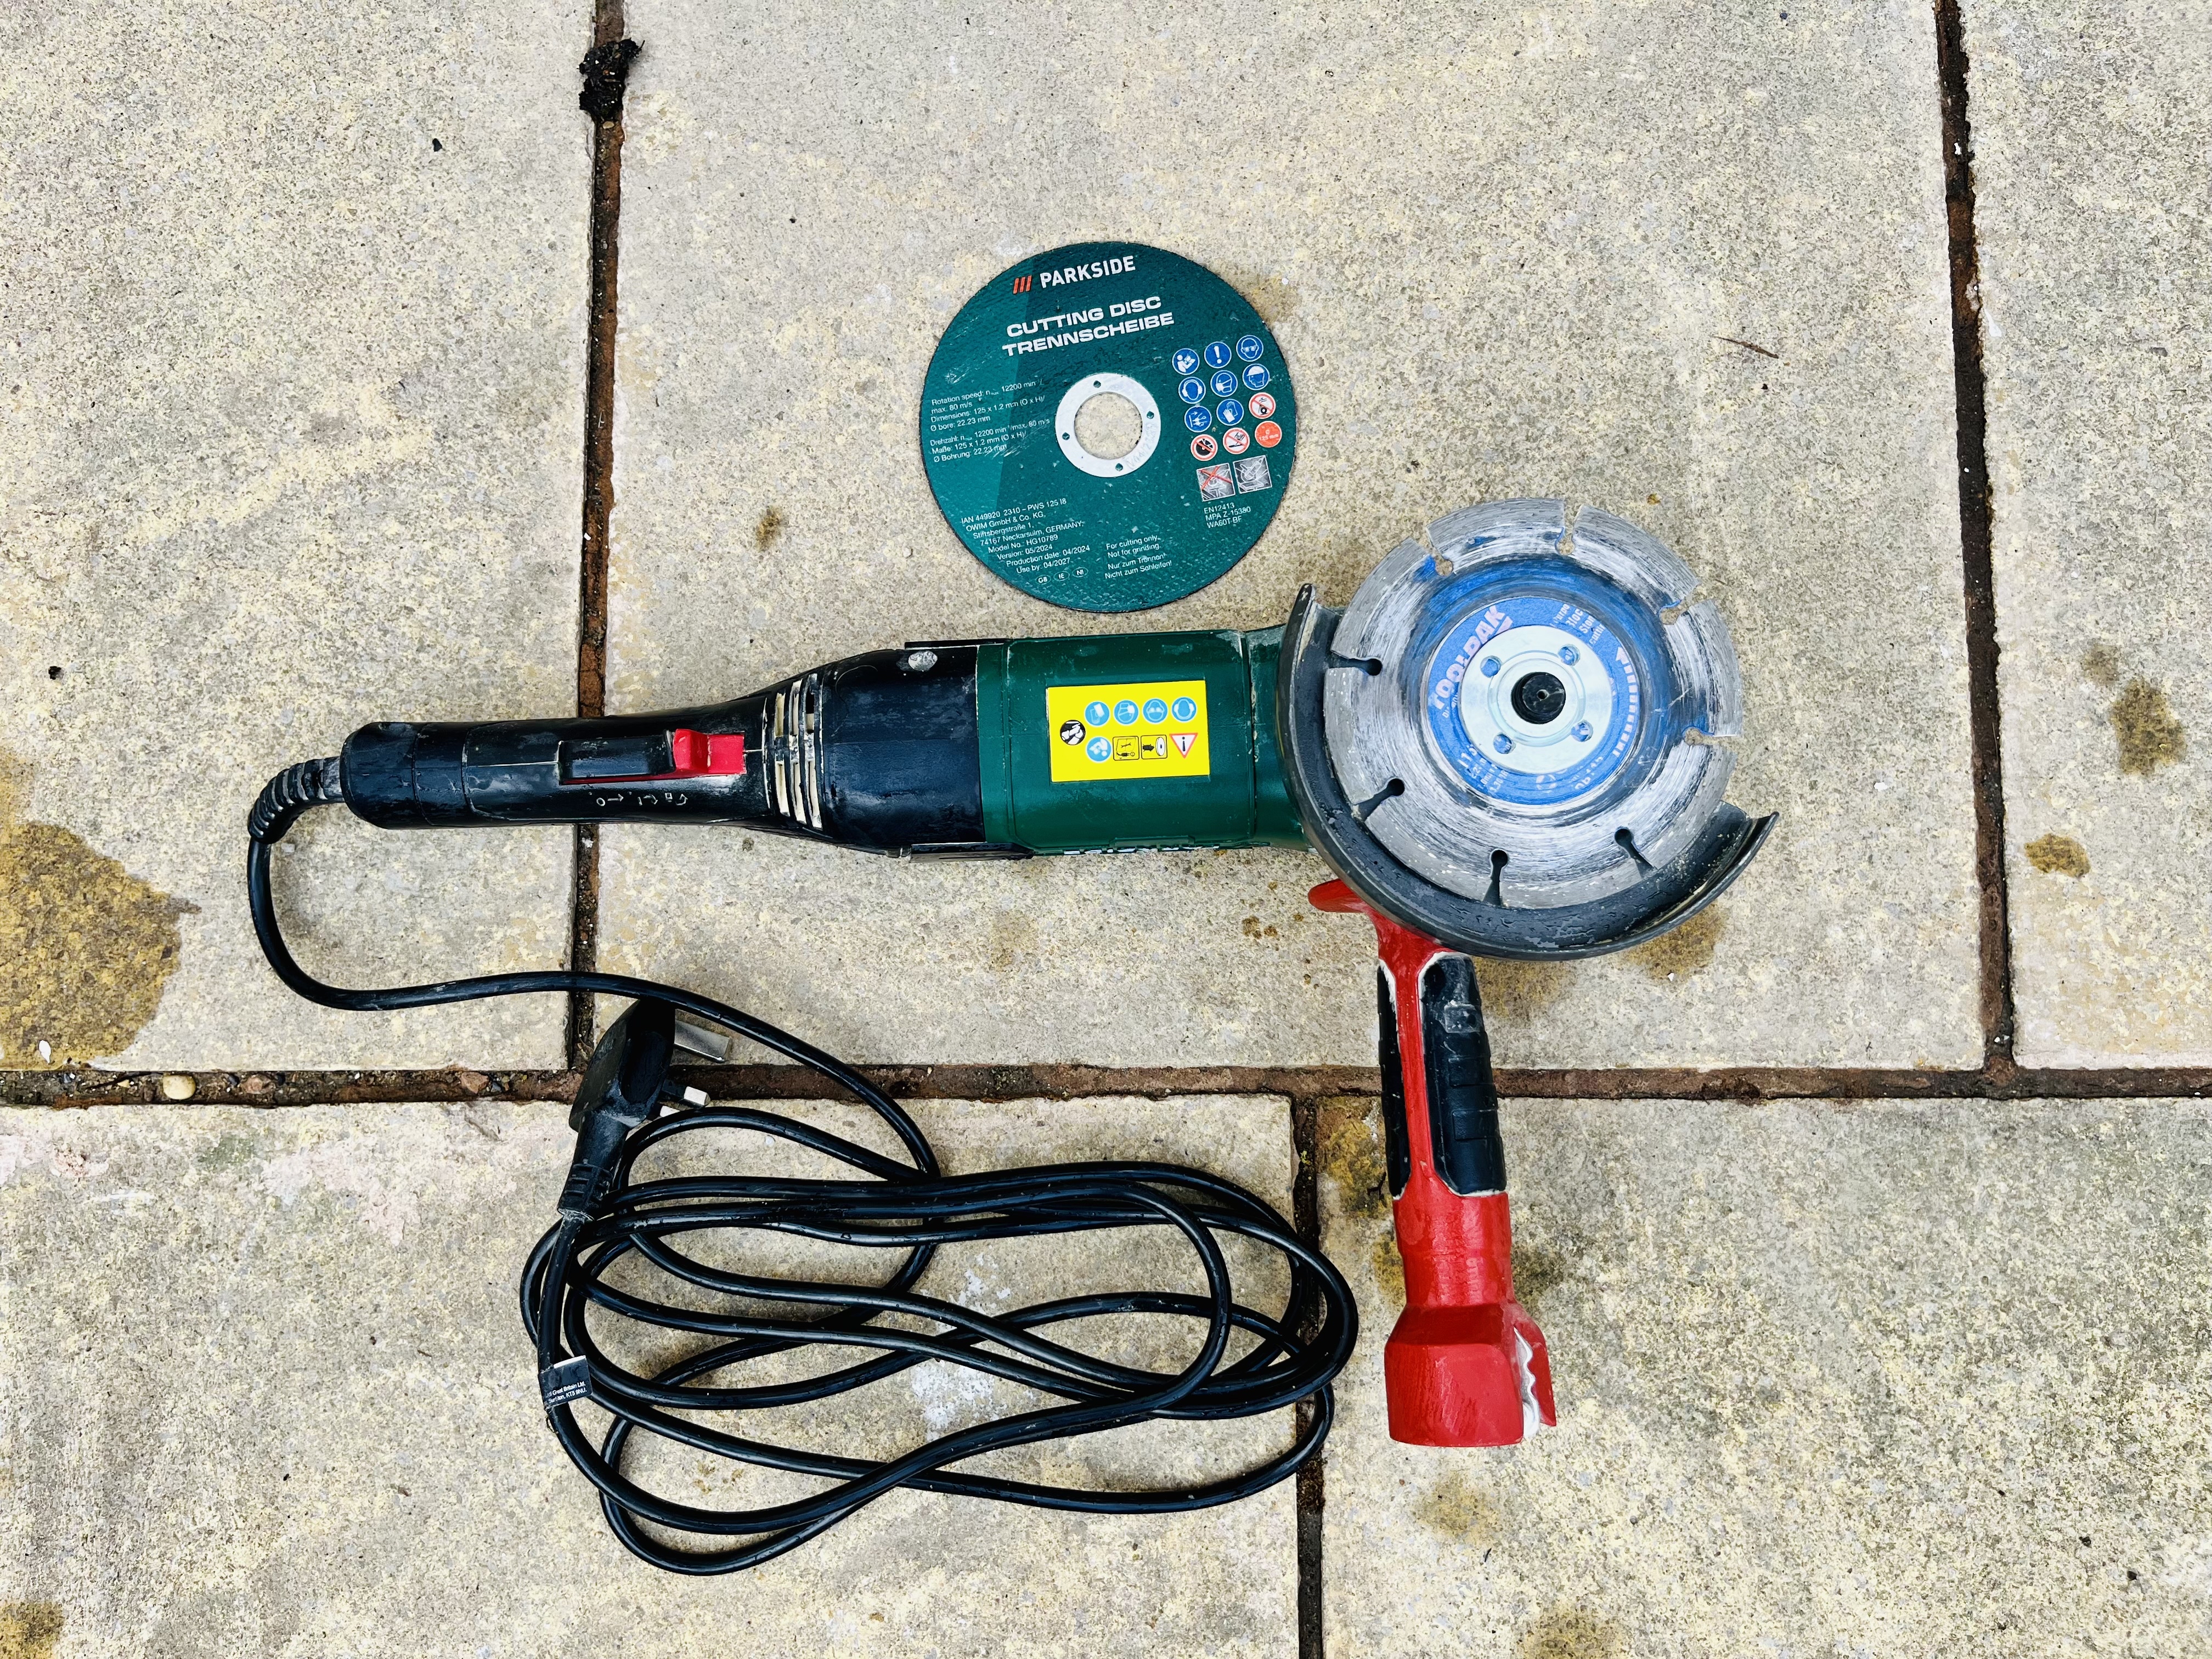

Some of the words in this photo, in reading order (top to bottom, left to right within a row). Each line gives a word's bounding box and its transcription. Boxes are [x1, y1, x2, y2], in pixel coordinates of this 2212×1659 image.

[1040, 255, 1136, 289] PARKSIDE
[1006, 307, 1104, 338] CUTTING
[1109, 296, 1161, 318] DISC
[1002, 312, 1175, 357] TRENNSCHEIBE
[932, 396, 960, 405] Rotation
[961, 390, 984, 400] speed:
[1001, 383, 1022, 392] 12200
[960, 401, 973, 409] m/s
[931, 411, 972, 422] Dimensions:
[974, 407, 986, 415] 125
[957, 417, 976, 427] 22.23
[930, 436, 958, 447] Drehzahl:
[975, 428, 994, 438] 12200
[975, 439, 985, 447] 1.2
[941, 451, 972, 461] Bohrung:
[973, 446, 992, 456] 22.23
[961, 516, 974, 524] IAN
[975, 511, 1001, 521] 449920
[1003, 507, 1020, 516] 2310
[1028, 502, 1045, 511] PWS
[1046, 499, 1059, 507] 125
[1204, 502, 1235, 514] EN12413
[1205, 512, 1222, 521] MPA
[1222, 506, 1251, 518] Z-15380
[966, 522, 988, 532] OWIM
[989, 517, 1011, 527] GmbH
[973, 523, 1026, 539] Stiftsbergstraße
[980, 537, 1001, 546] 74167
[988, 545, 1009, 554] Model
[1026, 534, 1058, 546] HG10789
[1119, 538, 1143, 548] cutting
[996, 550, 1024, 560] Version:
[1025, 544, 1053, 555] 05/2024
[1006, 555, 1043, 567] Production
[1044, 551, 1062, 560] date:
[1062, 545, 1090, 556] 04/2024
[1043, 557, 1070, 568] 04/2027
[1104, 570, 1123, 579] Nicht
[1124, 567, 1139, 575] zum
[1139, 560, 1172, 572] Schleifen!
[552, 1387, 563, 1396] Great
